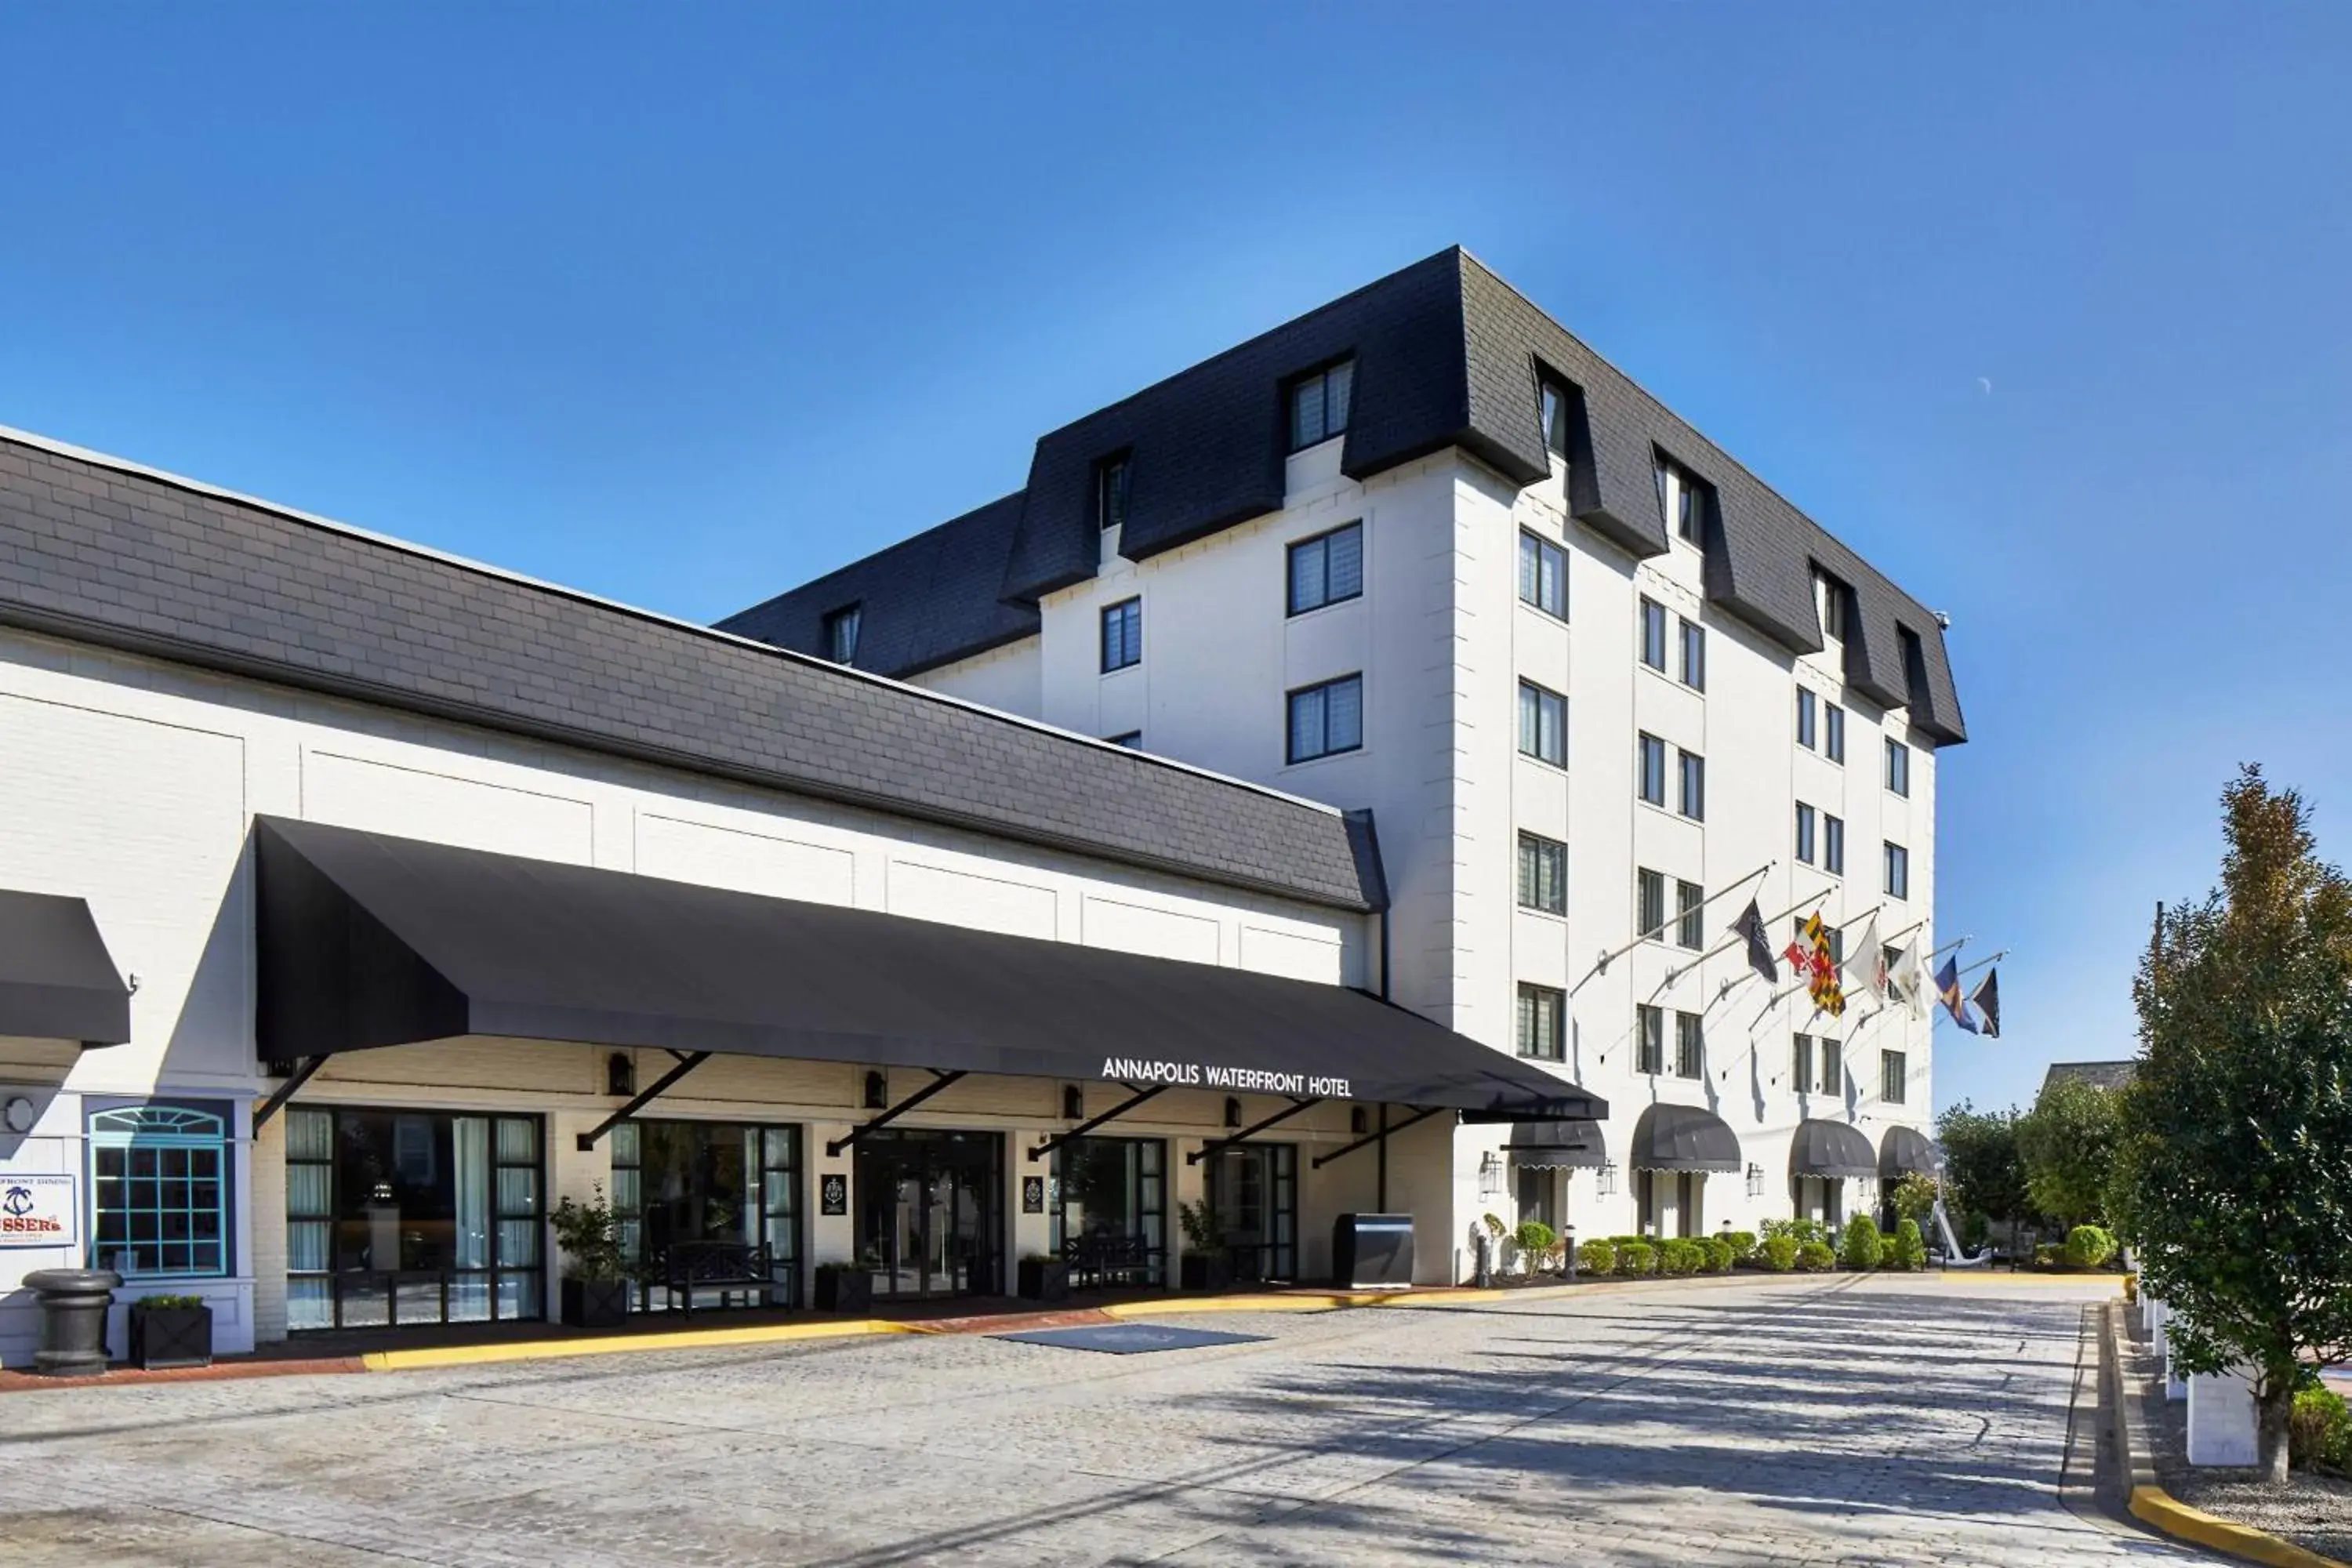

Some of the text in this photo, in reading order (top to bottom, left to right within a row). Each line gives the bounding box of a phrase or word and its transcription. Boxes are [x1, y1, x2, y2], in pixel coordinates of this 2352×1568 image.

[1102, 1058, 1352, 1097] ANNAPOLIS WATERFRONT HOTEL
